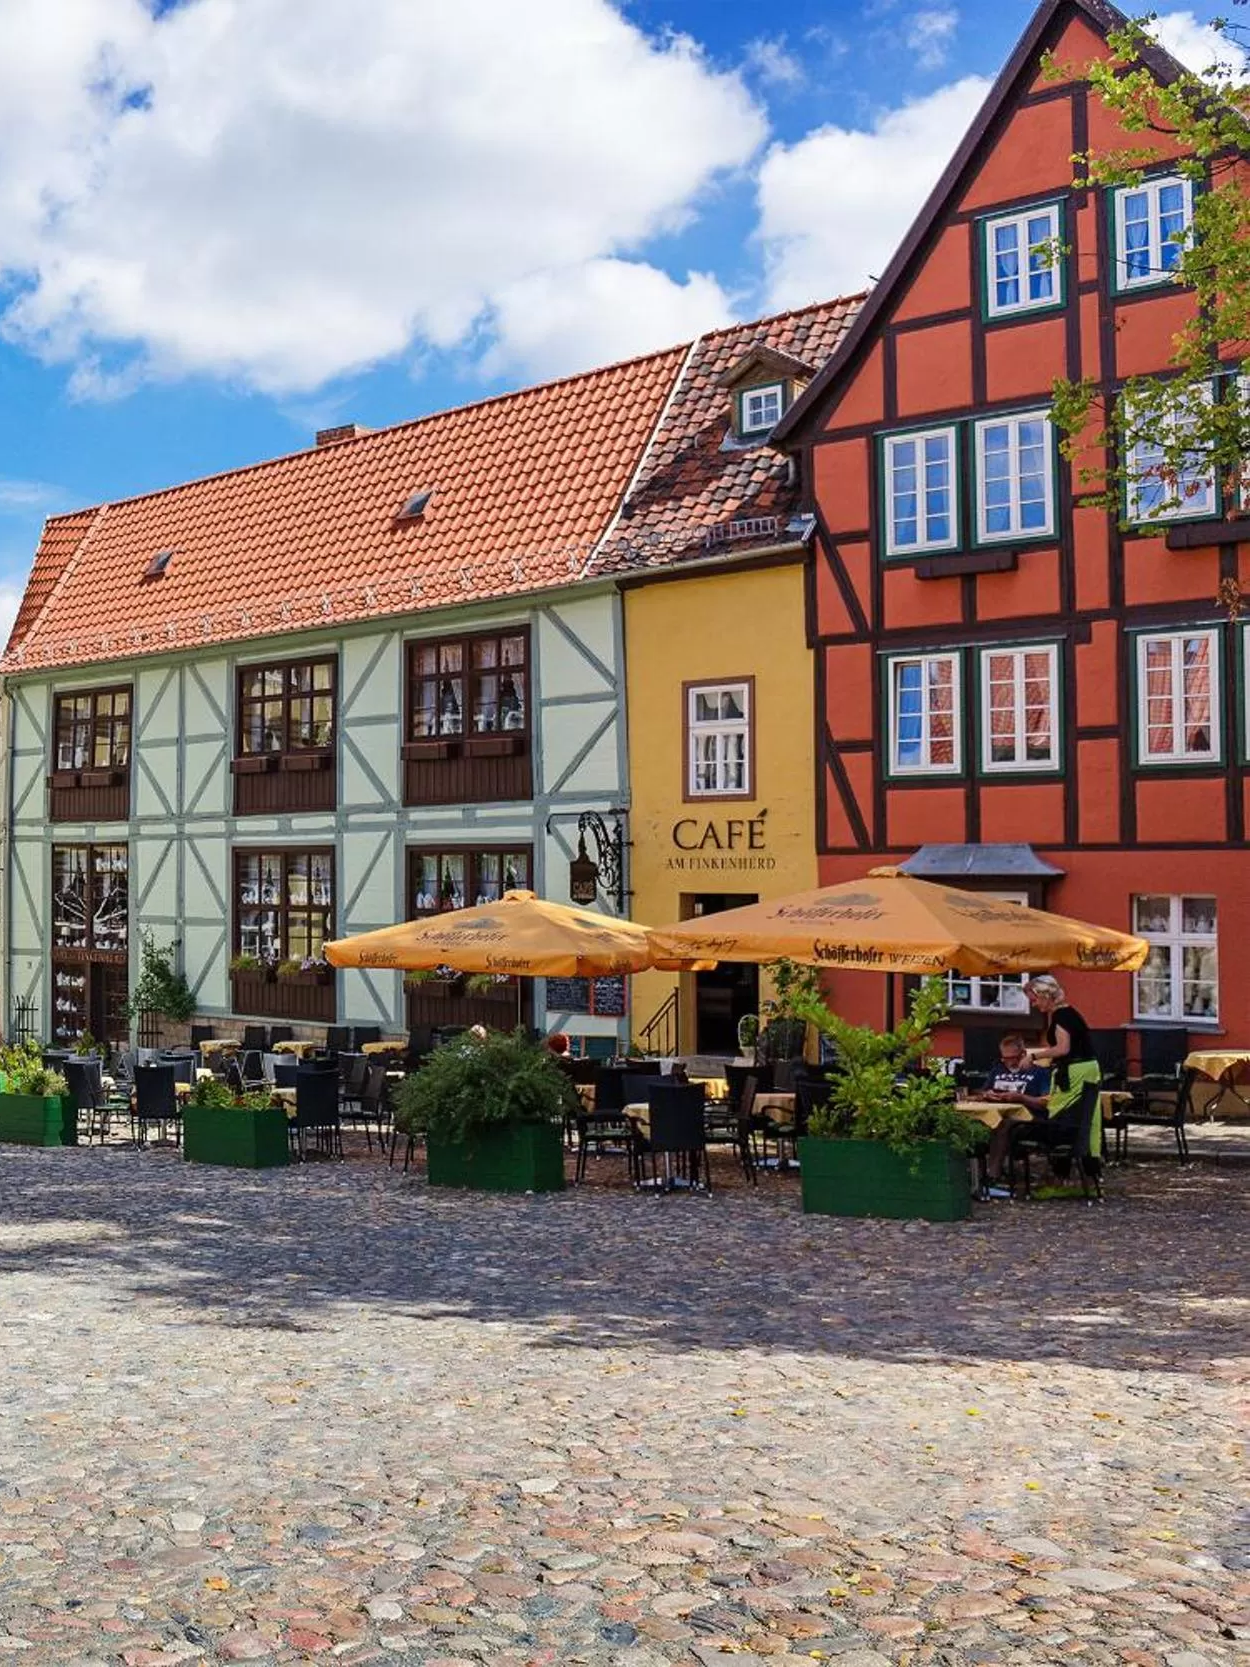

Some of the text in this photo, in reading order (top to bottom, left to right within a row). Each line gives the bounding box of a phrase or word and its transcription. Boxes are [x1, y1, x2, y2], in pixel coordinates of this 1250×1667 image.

[672, 808, 768, 850] CAFÉ
[668, 858, 776, 869] AM FINKENHERD
[812, 938, 946, 967] Schöfferhofer WEIZEN
